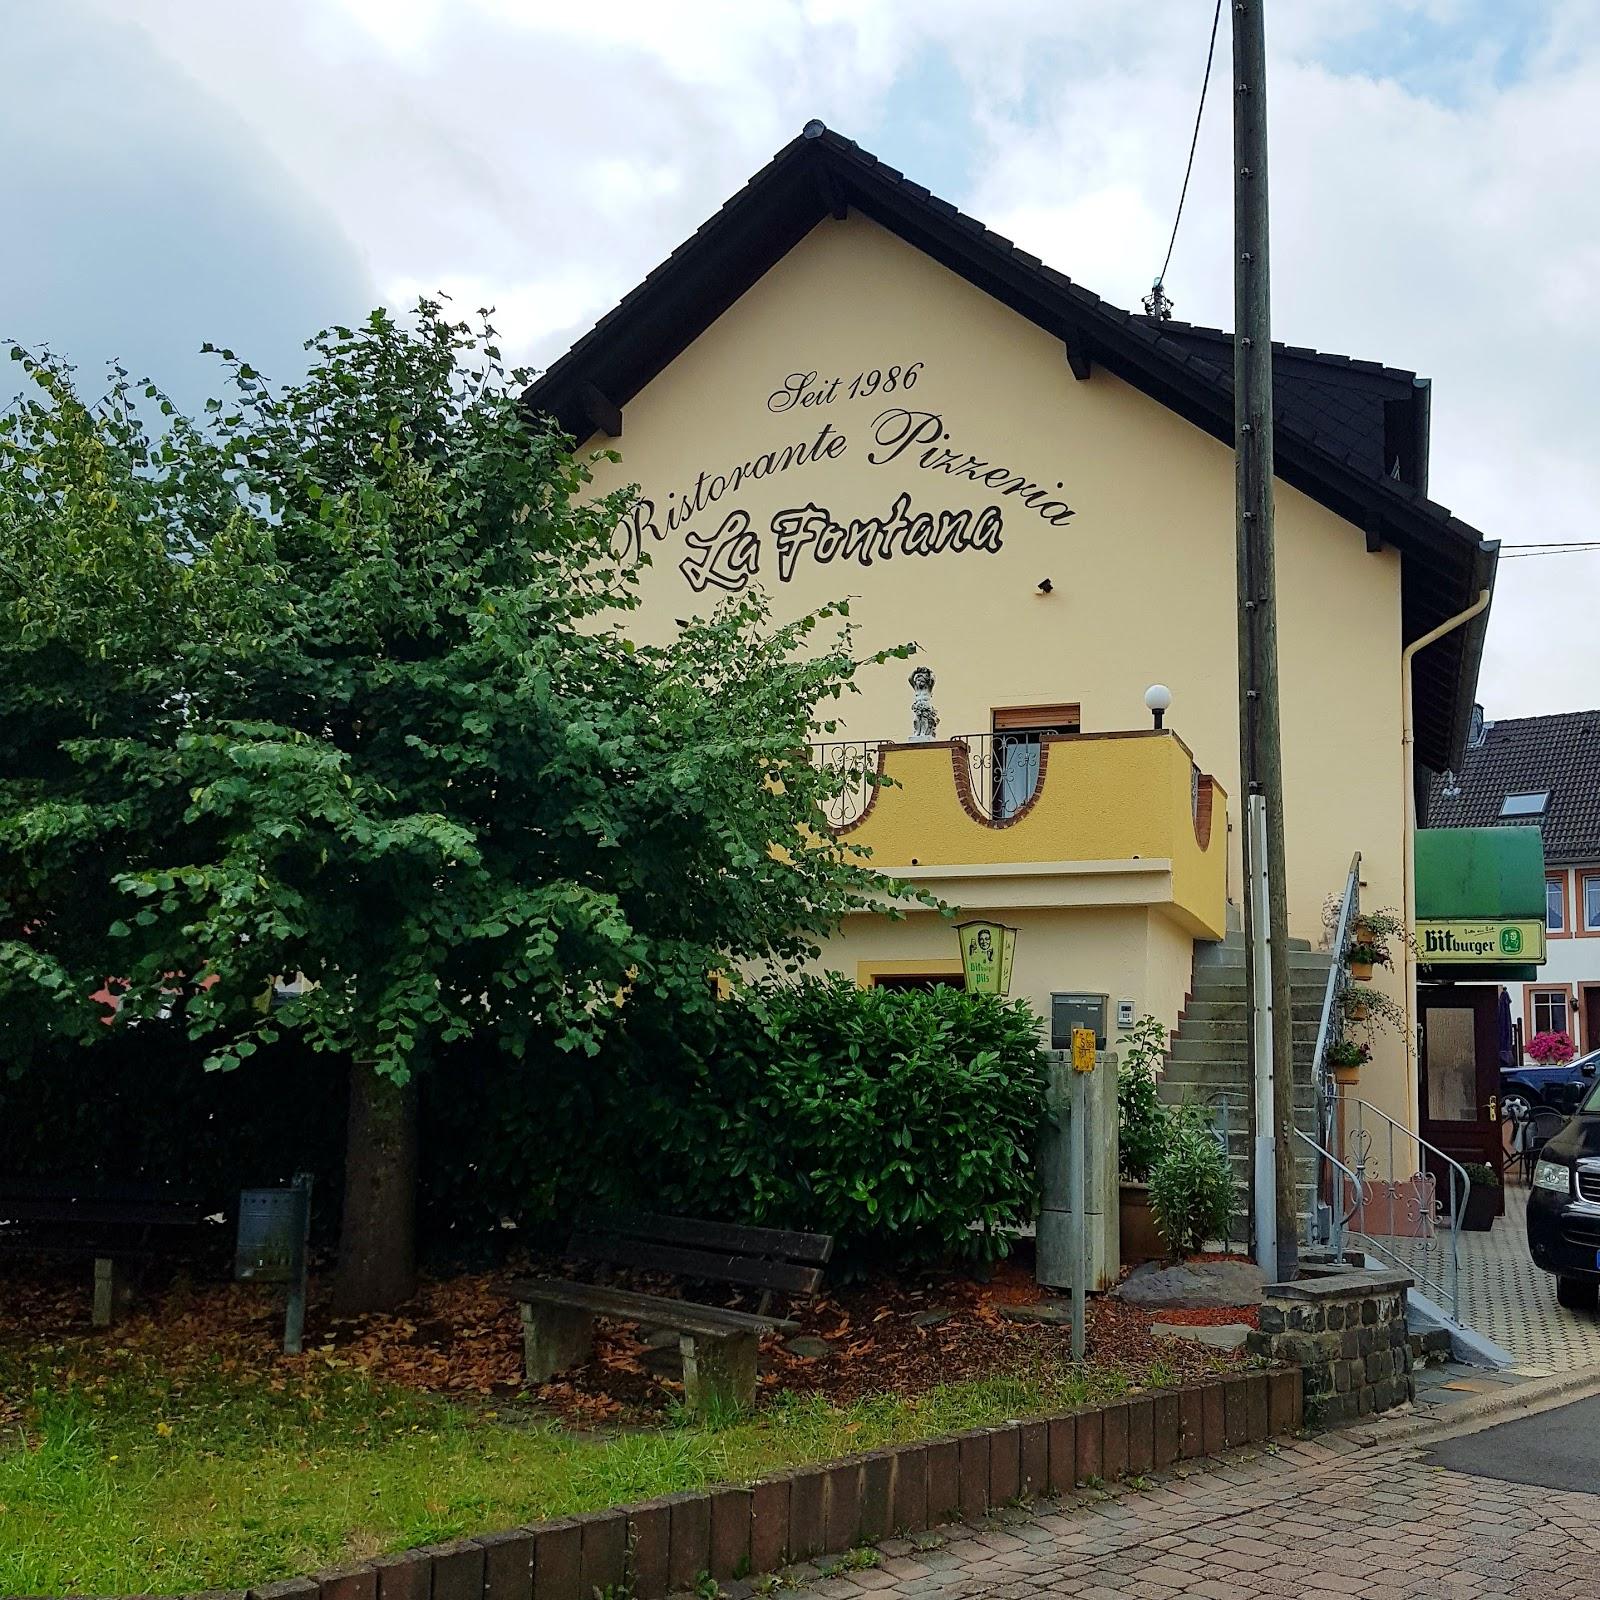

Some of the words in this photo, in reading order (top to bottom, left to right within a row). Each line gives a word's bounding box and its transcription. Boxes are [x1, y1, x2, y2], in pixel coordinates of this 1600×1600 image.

[768, 370, 843, 413] Seit
[848, 362, 925, 400] 1986
[610, 423, 848, 563] Ristorante
[868, 408, 1080, 528] Pizzeria
[679, 509, 760, 593] La
[771, 492, 1004, 583] Fontana
[1425, 929, 1495, 955] Bitburger
